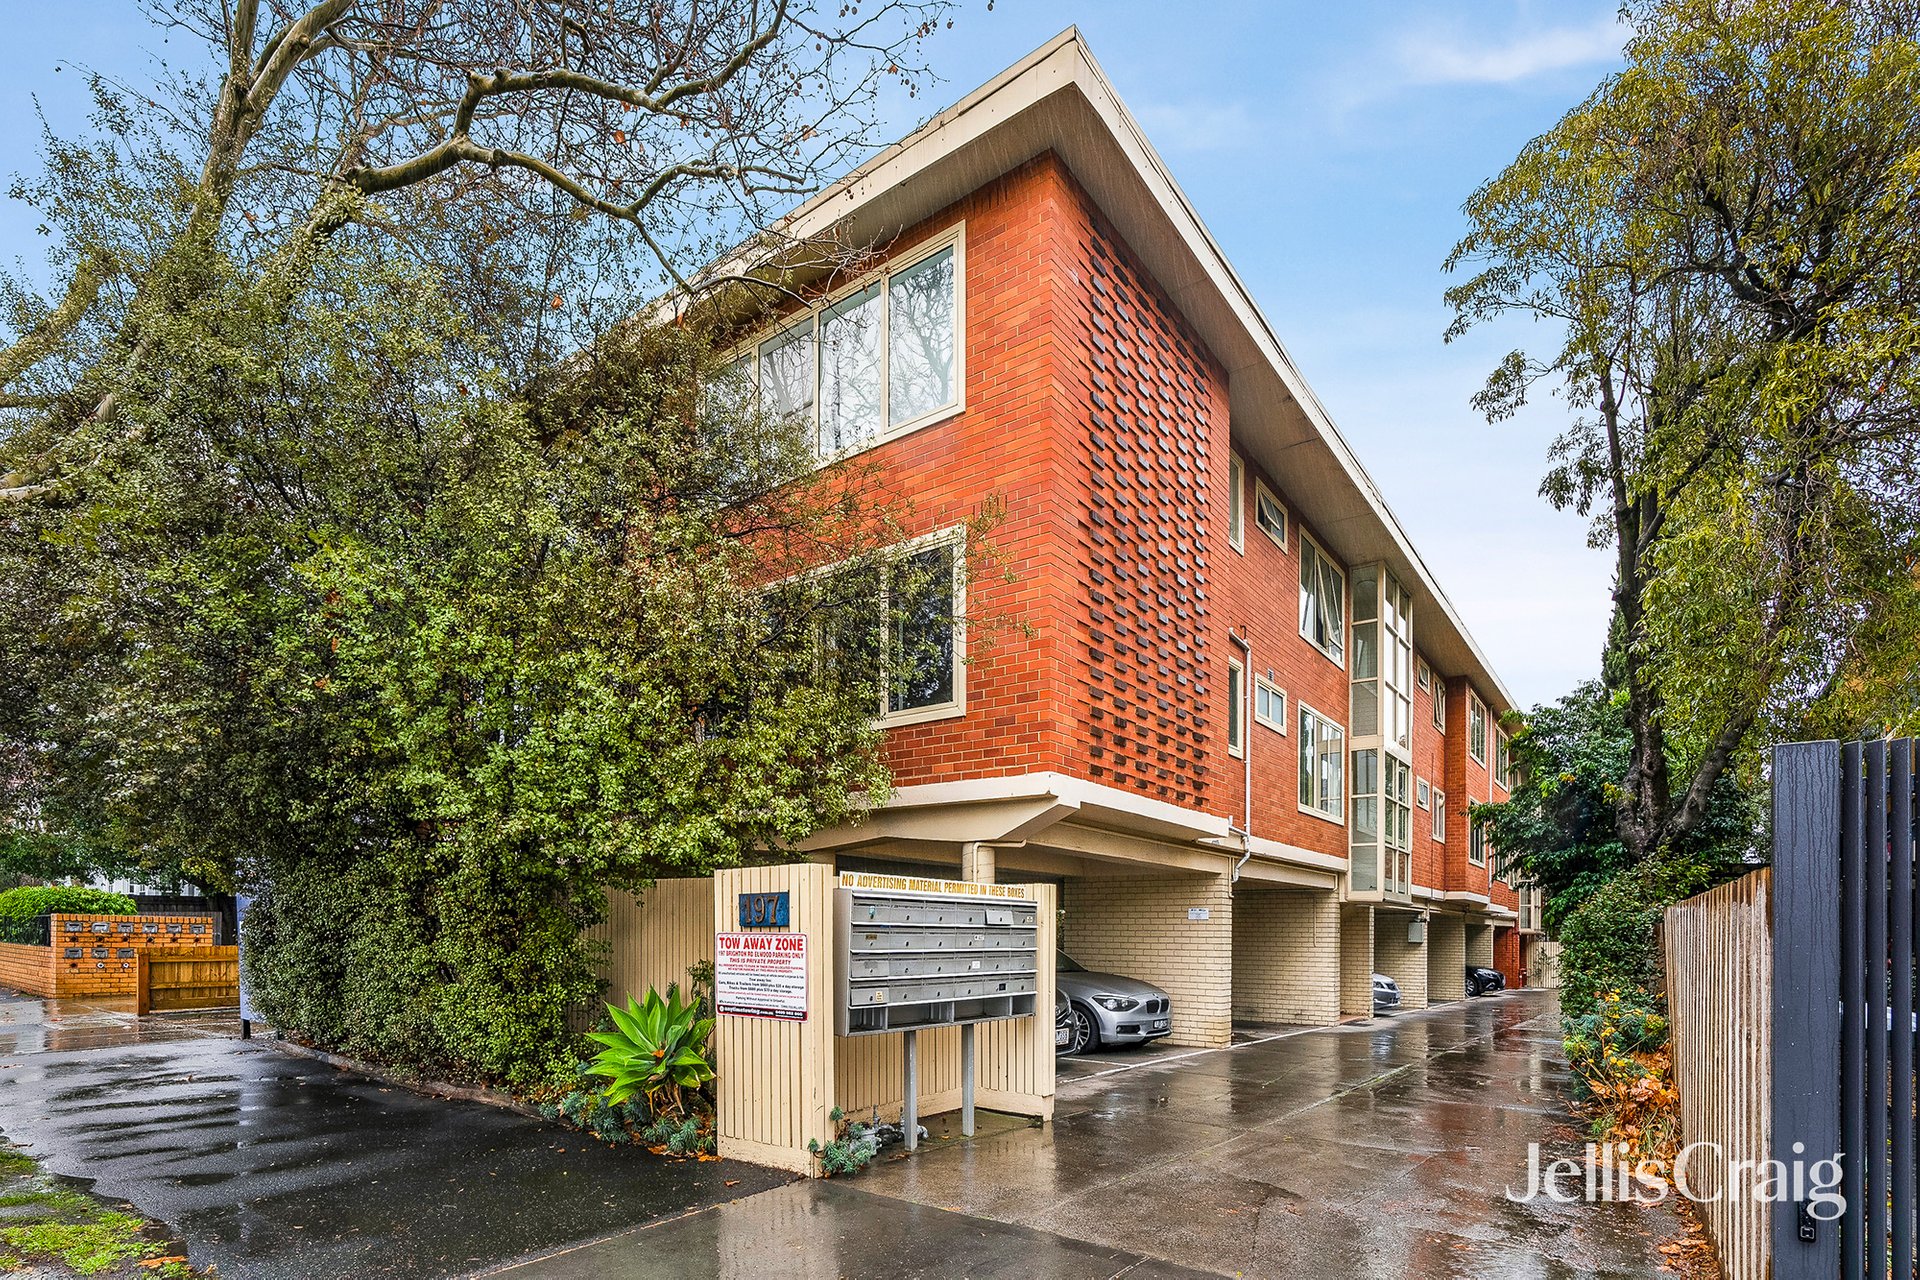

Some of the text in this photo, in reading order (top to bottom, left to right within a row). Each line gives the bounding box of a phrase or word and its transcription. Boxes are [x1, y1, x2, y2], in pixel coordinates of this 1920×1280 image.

[842, 874, 1024, 898] NO ADVERTISING MATERIAL PERMITTED IN THESE BOXES
[744, 895, 779, 924] 197
[719, 937, 804, 951] TOW AWAY ZONE
